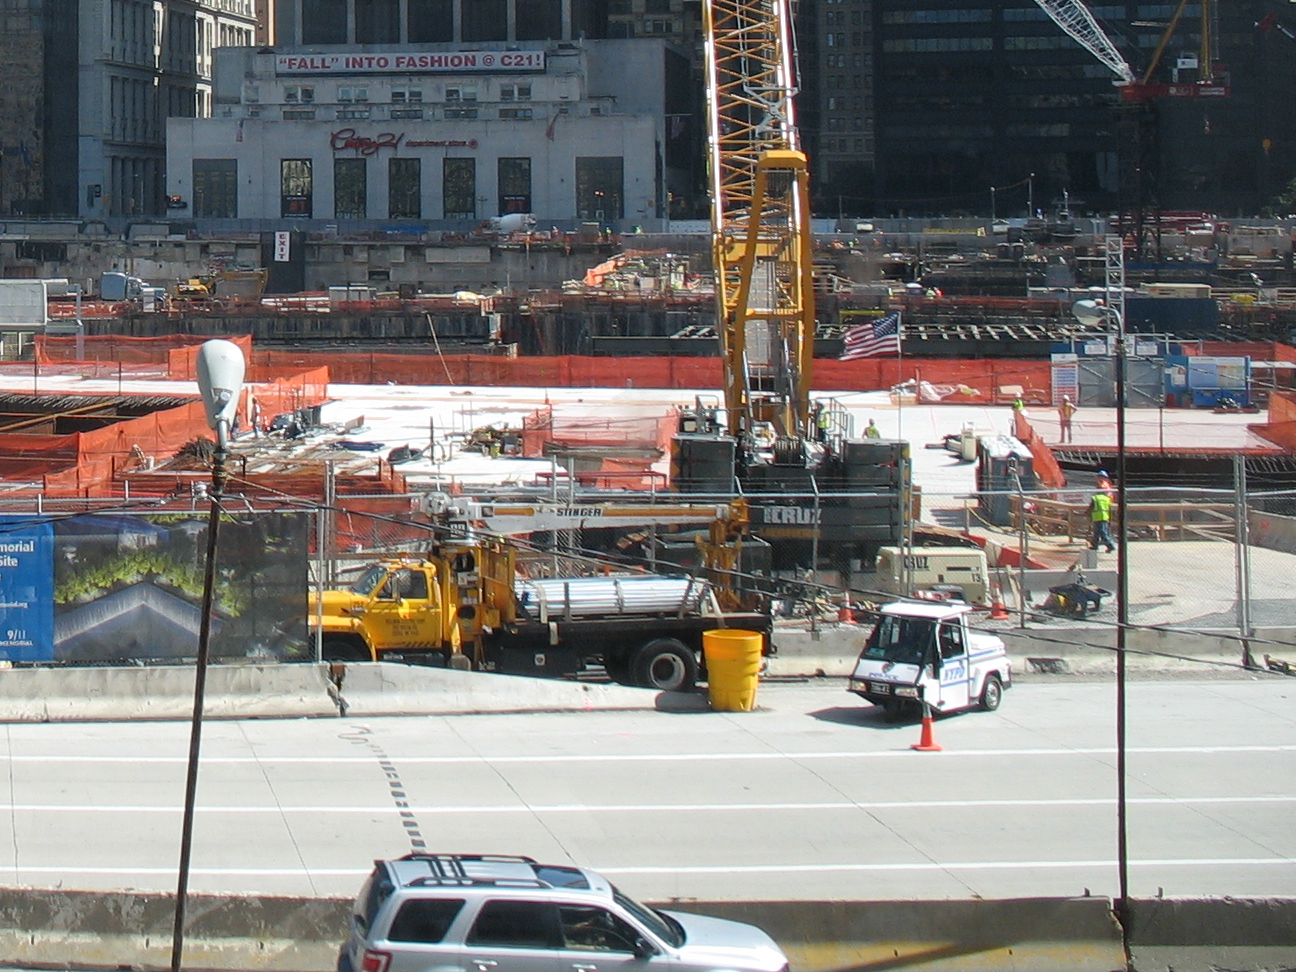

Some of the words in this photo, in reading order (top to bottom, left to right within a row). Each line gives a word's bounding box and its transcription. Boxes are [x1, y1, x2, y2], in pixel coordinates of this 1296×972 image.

[345, 56, 389, 69] INTO
[396, 54, 477, 69] FASHION
[482, 55, 495, 67] @
[500, 54, 542, 67] C21!
[278, 233, 287, 260] EXIT
[556, 507, 602, 517] STINGER
[971, 573, 981, 583] 13
[7, 630, 26, 640] 9/11
[943, 666, 966, 681] NYPD
